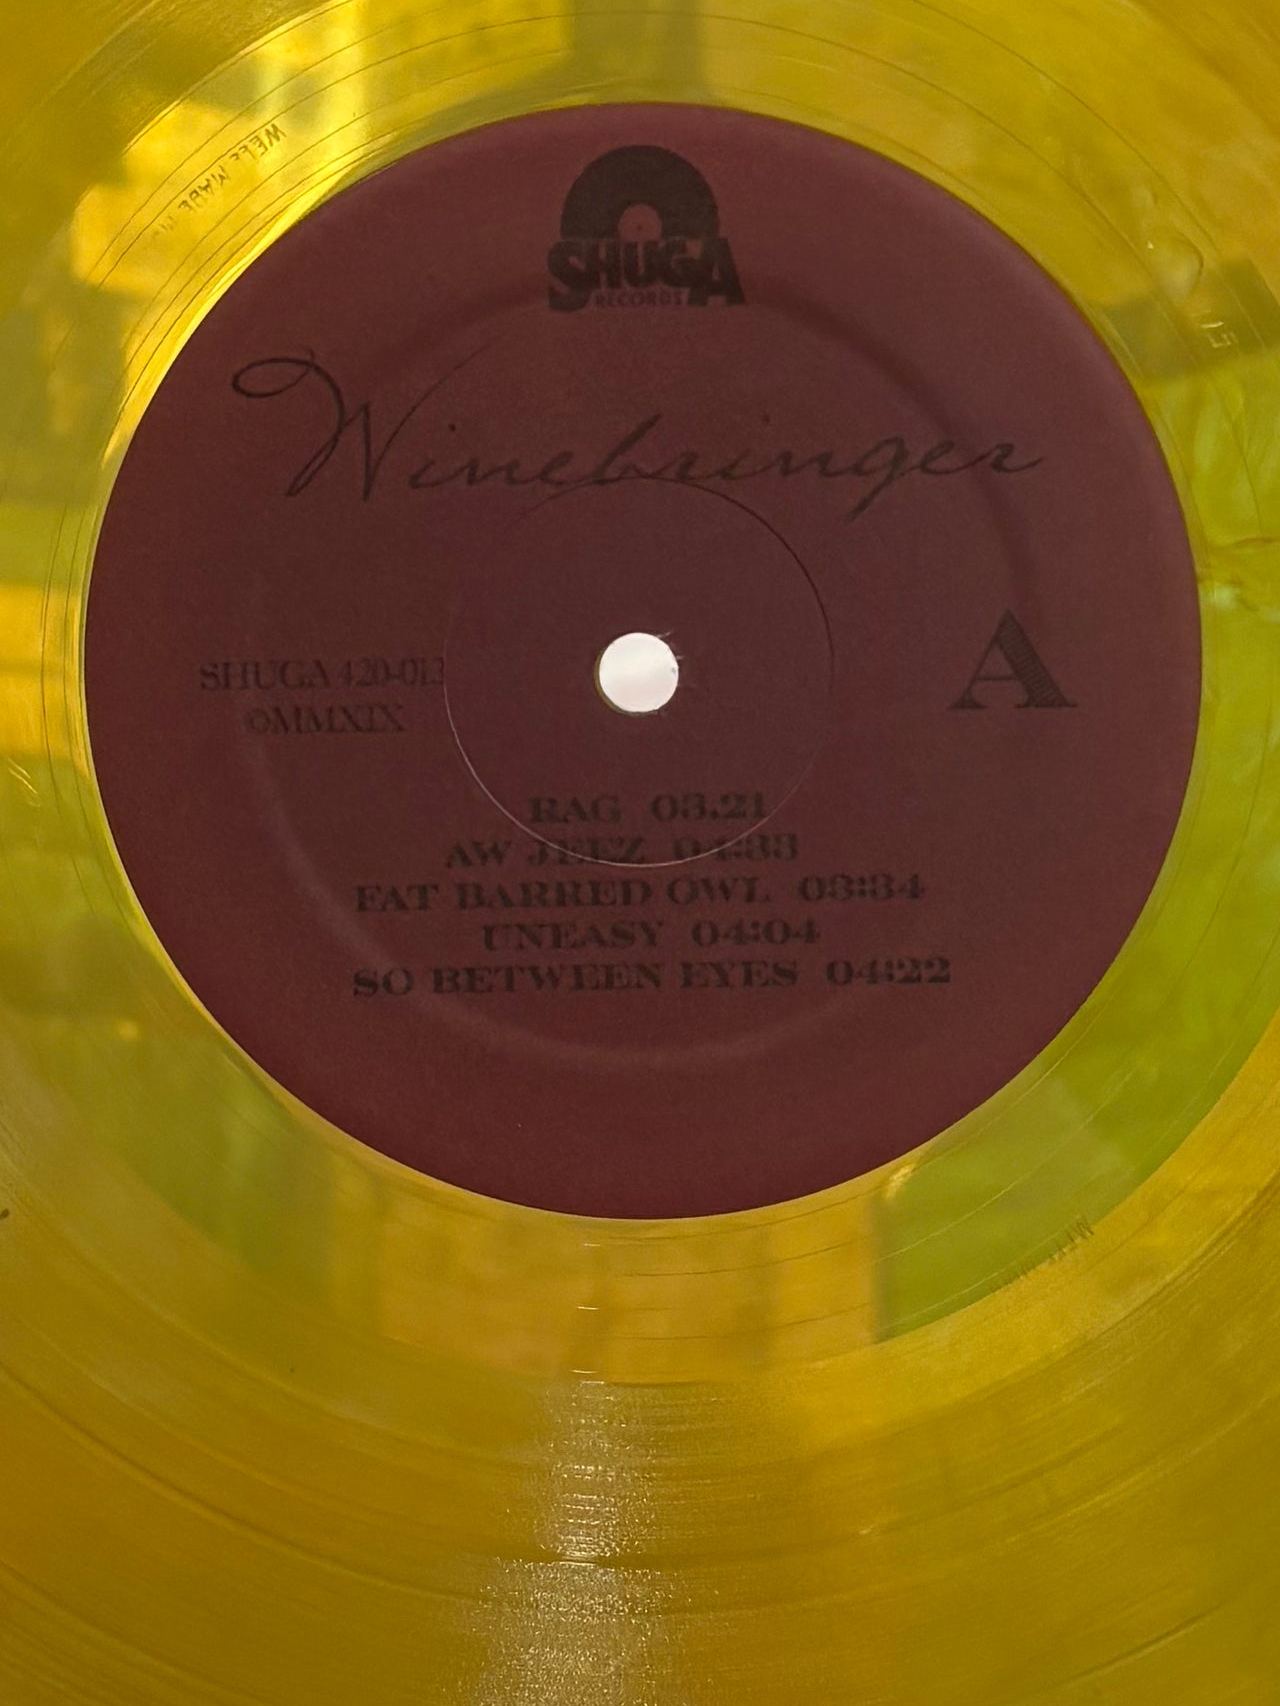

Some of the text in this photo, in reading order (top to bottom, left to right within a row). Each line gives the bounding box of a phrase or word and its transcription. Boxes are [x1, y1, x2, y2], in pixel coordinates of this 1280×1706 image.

[547, 238, 746, 312] SHUGA
[232, 338, 1046, 522] Winebringer
[200, 658, 333, 692] SHUGA
[946, 607, 1078, 711] A
[529, 794, 621, 826] RAG
[446, 839, 510, 870] AW
[528, 834, 646, 867] JEEZ
[355, 882, 438, 914] FAT
[456, 878, 651, 911] BARRED
[667, 875, 772, 907] OWL
[482, 917, 821, 952] UNEASY 04:04
[352, 954, 953, 999] SO BETWEEN EYES 04:22
